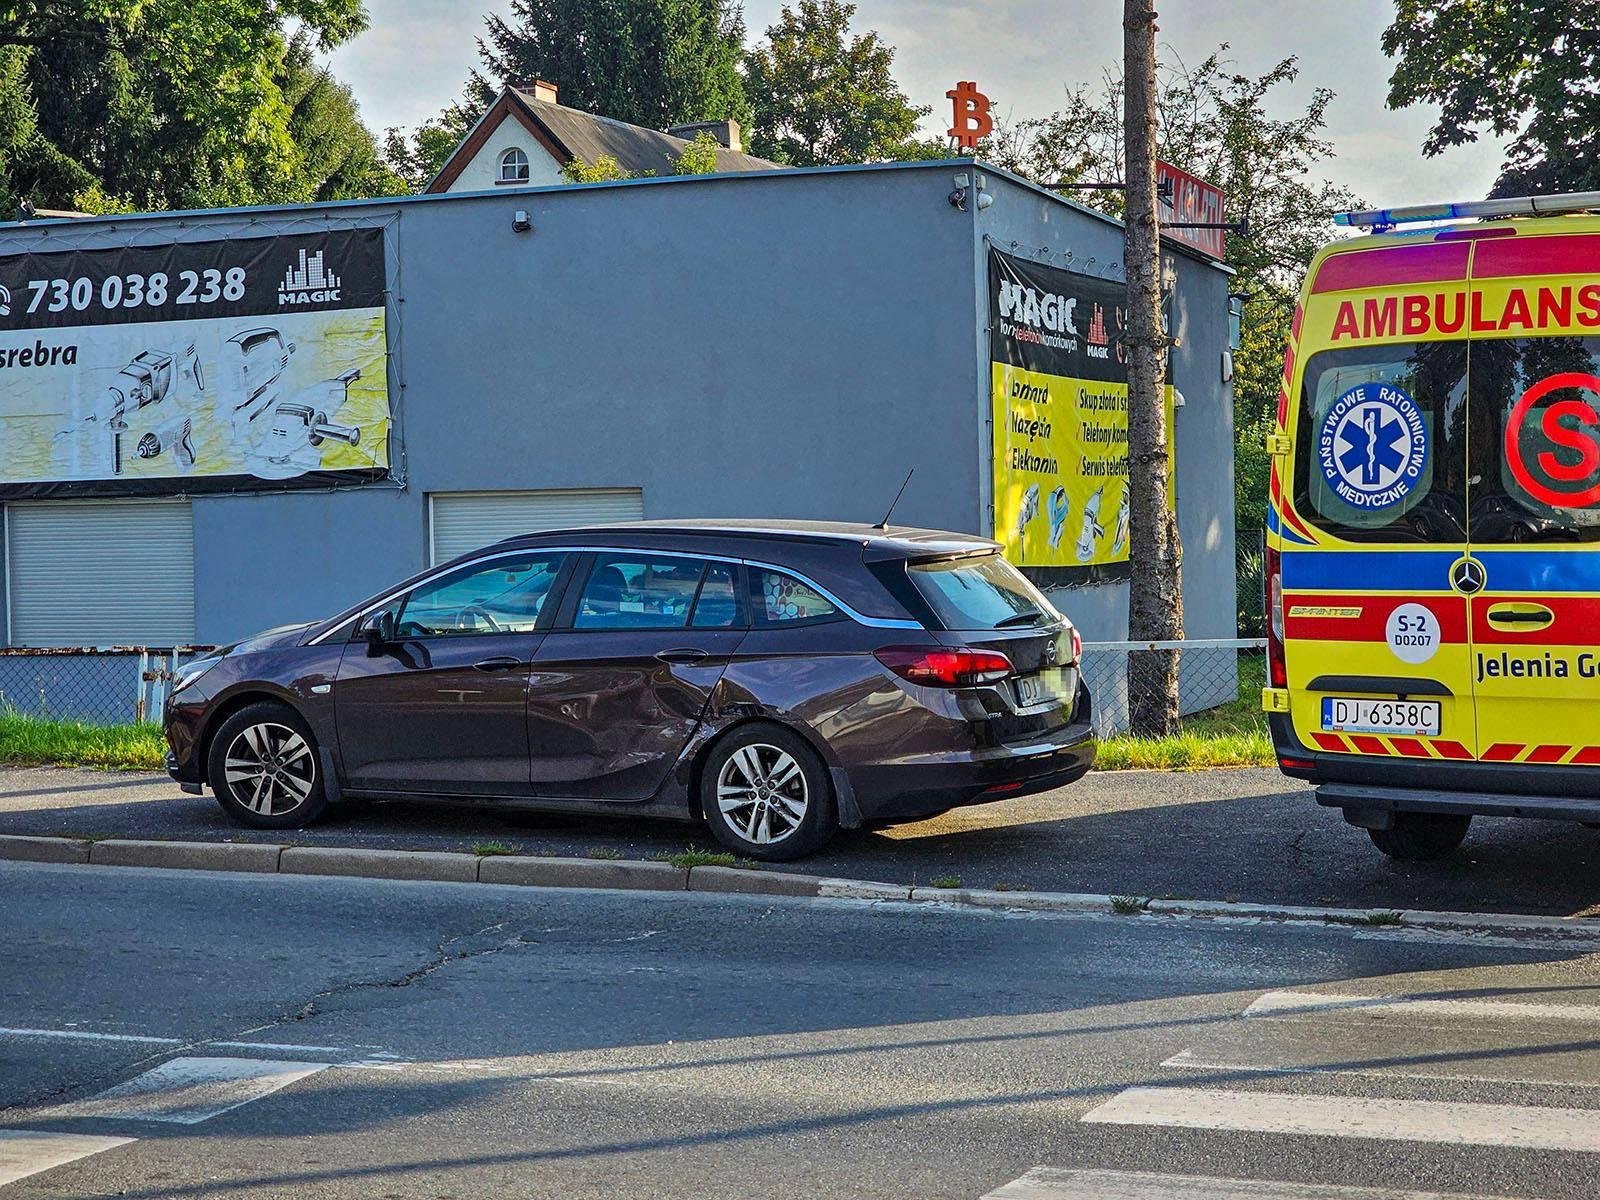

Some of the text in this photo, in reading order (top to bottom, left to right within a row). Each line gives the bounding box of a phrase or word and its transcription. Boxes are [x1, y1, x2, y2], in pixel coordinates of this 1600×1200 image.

[27, 267, 246, 313] 730 038 238
[278, 290, 341, 305] MAGIC
[999, 280, 1077, 335] MAGIC
[0, 339, 78, 368] srebra
[1087, 345, 1109, 359] MAGIC
[1080, 388, 1098, 415] Skup
[1082, 422, 1112, 448] Telefony
[1319, 387, 1425, 507] PAŃSTWOWE RATOWNICTWO MEDYCZNE
[1537, 400, 1600, 481] S
[1082, 456, 1105, 476] Serwis
[1398, 615, 1427, 632] S-2
[1395, 635, 1431, 646] D0207
[1477, 652, 1600, 683] Jelenia G
[1336, 702, 1432, 727] DJ 6358C
